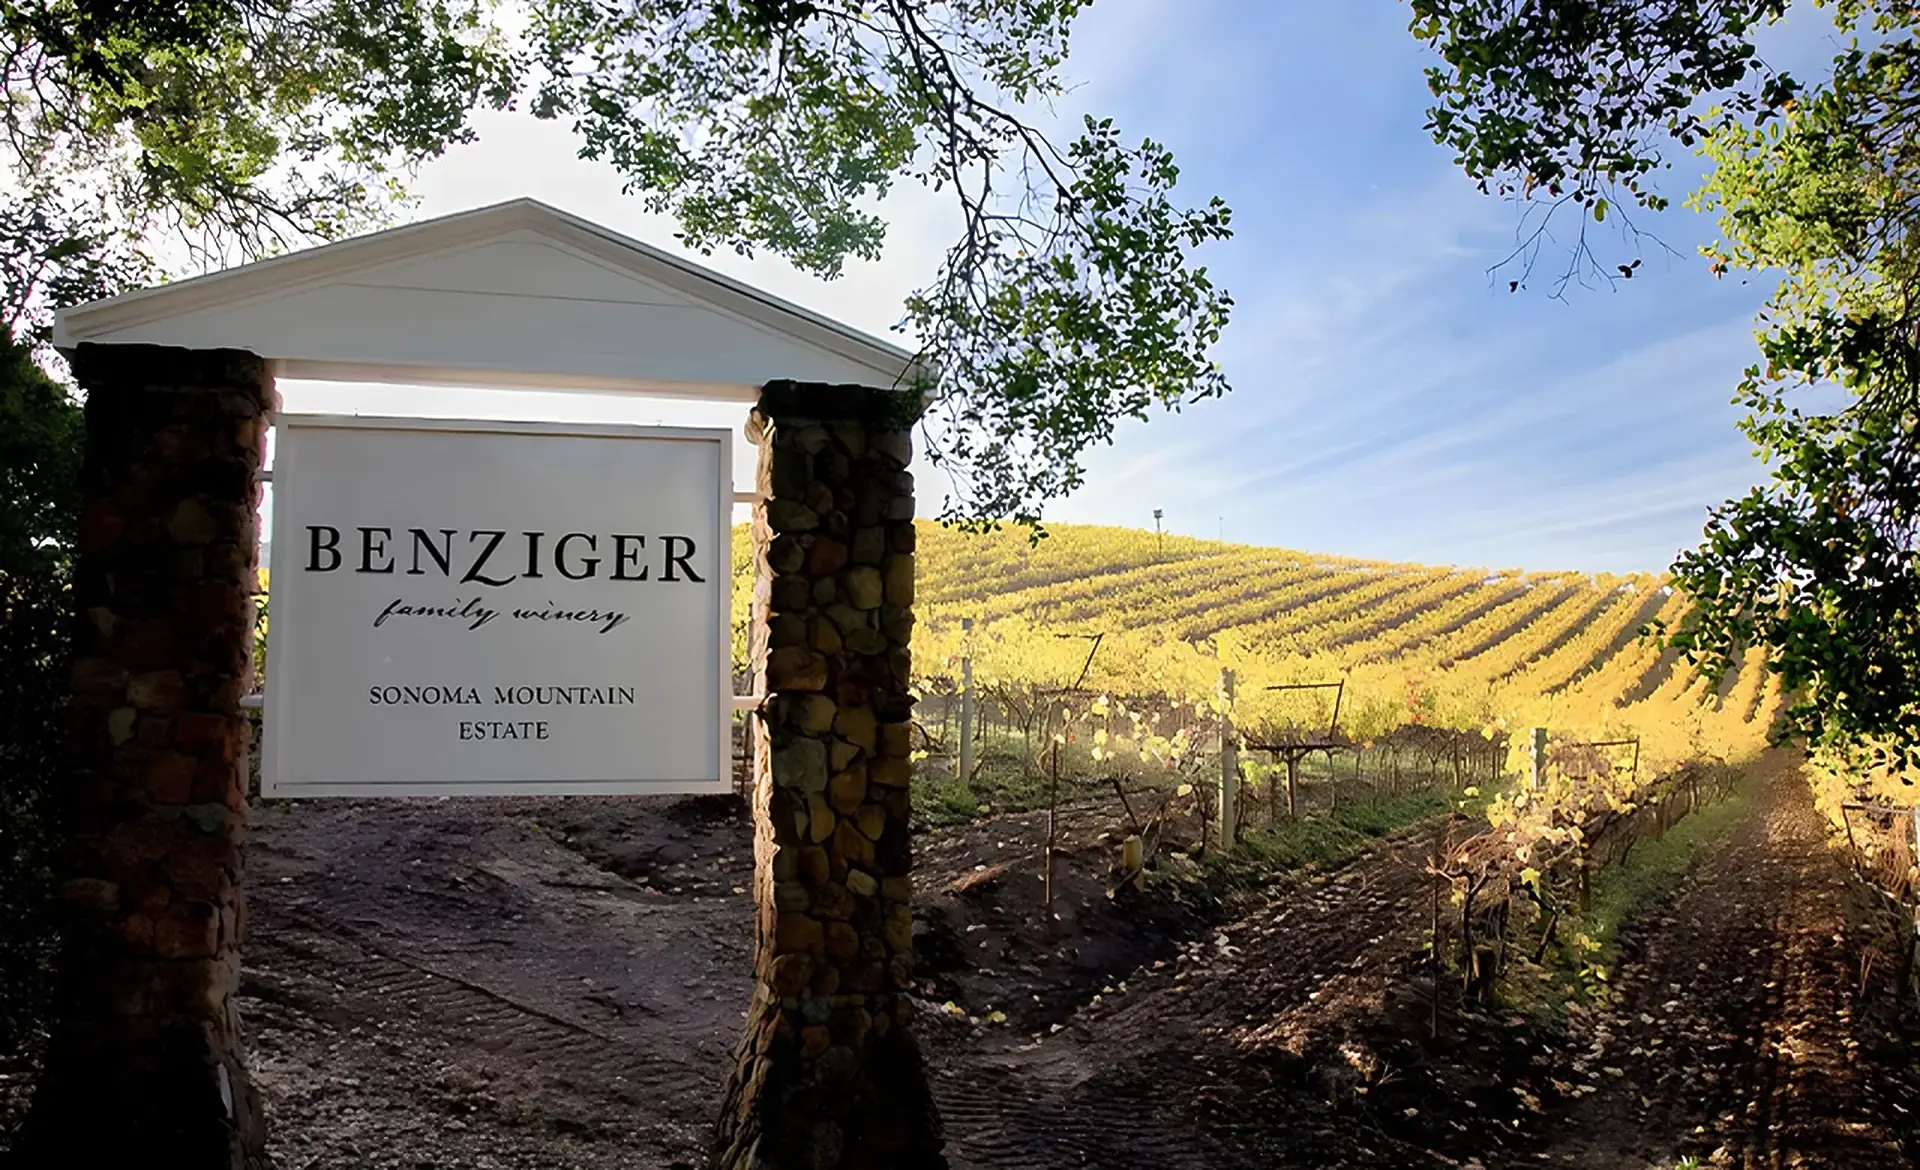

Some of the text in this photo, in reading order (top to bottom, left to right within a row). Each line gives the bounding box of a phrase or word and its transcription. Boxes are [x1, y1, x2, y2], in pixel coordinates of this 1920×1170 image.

[304, 525, 706, 587] BENZIGER
[373, 597, 631, 635] family winery
[369, 685, 636, 706] SONOMA MOUNTAIN
[458, 721, 550, 741] ESTATE
